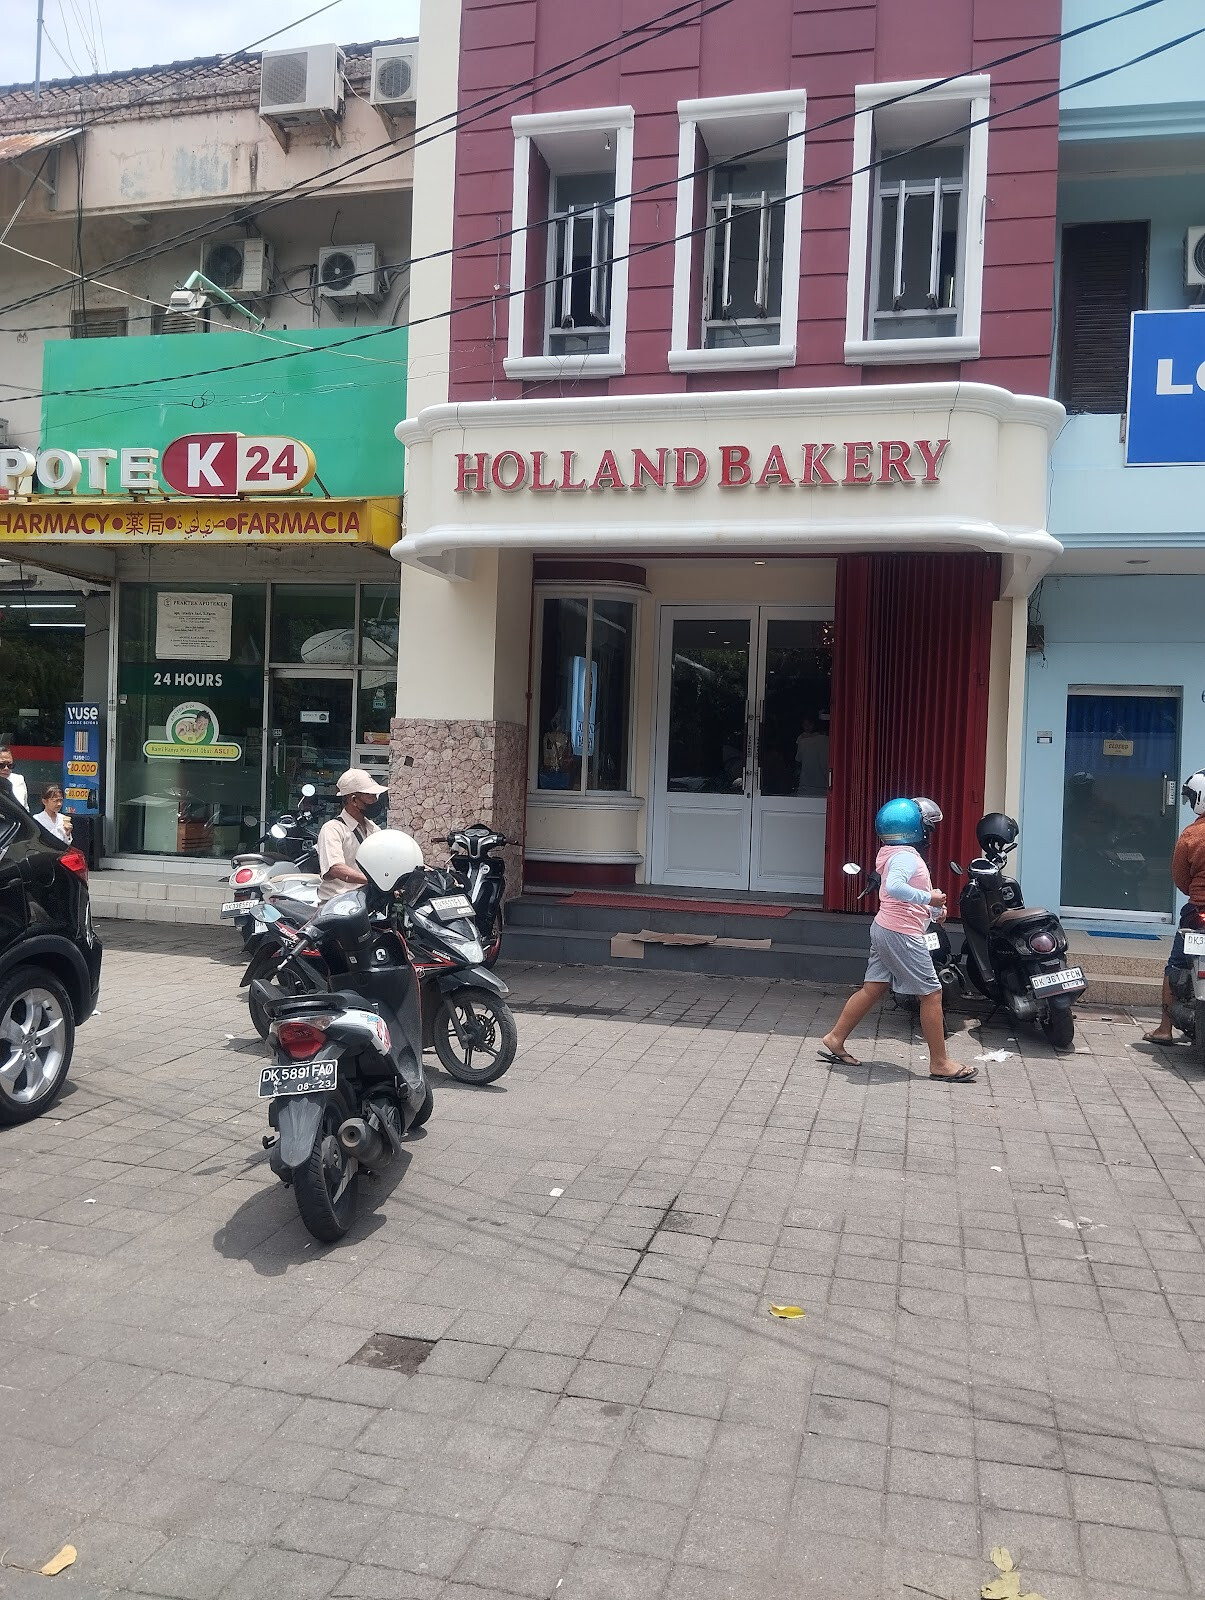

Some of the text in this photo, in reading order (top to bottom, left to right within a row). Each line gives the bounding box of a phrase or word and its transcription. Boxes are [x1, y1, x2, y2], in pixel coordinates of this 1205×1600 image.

[187, 442, 225, 488] K
[245, 444, 298, 482] 24
[453, 438, 951, 494] HOLLAND BAKERY
[125, 511, 165, 535] 薬局
[237, 511, 361, 534] FARMACIA
[153, 672, 223, 687] 24 HOURS
[1033, 969, 1081, 987] DK 3611 FCN
[262, 1069, 279, 1083] DK
[281, 1066, 310, 1080] 5891
